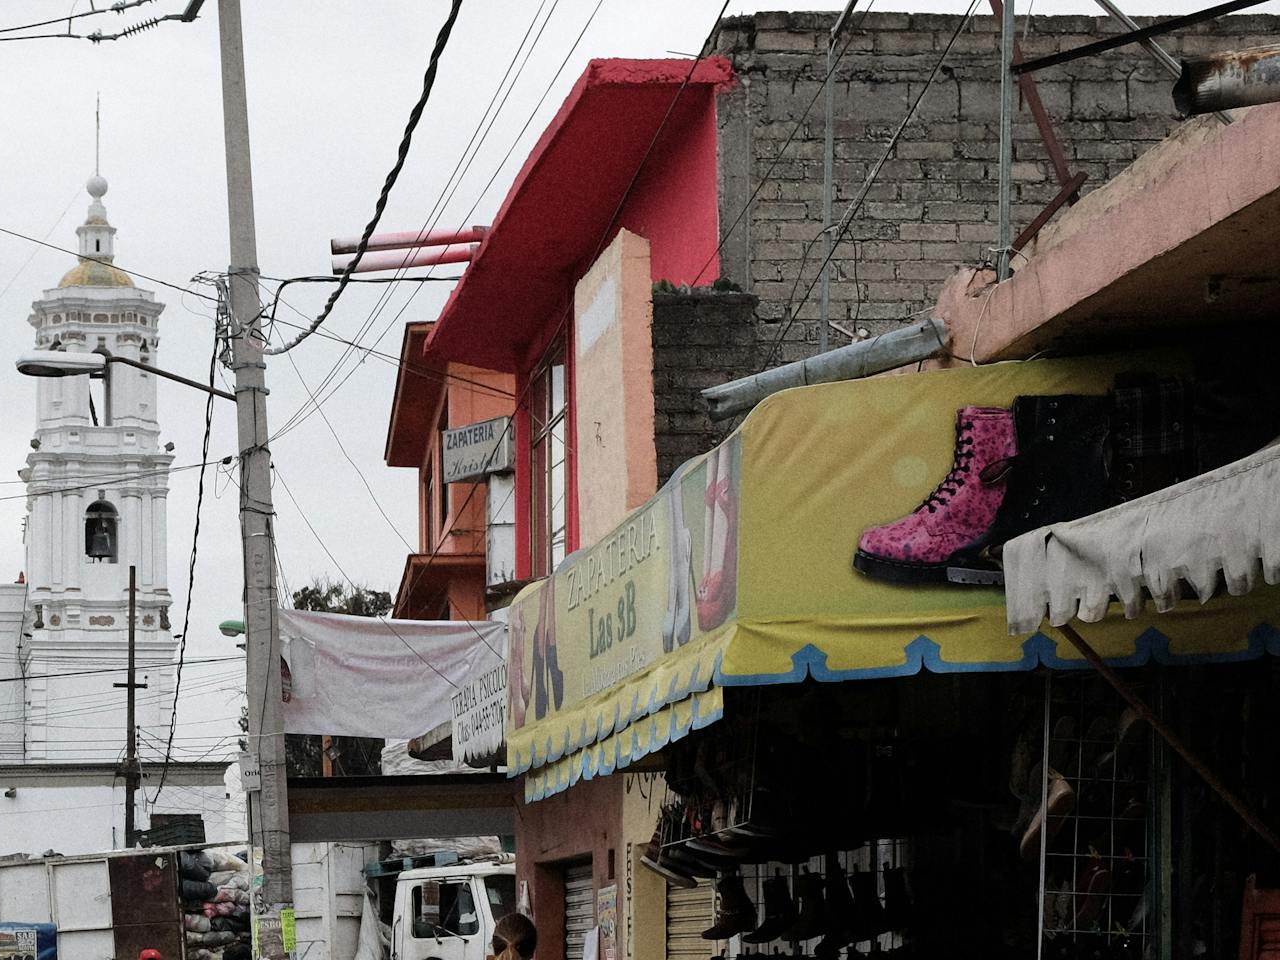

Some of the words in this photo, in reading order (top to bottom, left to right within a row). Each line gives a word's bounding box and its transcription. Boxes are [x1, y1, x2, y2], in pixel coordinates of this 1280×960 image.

[447, 423, 494, 450] ZAPATERIA
[567, 508, 661, 612] ZAPATERIA
[588, 607, 613, 660] Las
